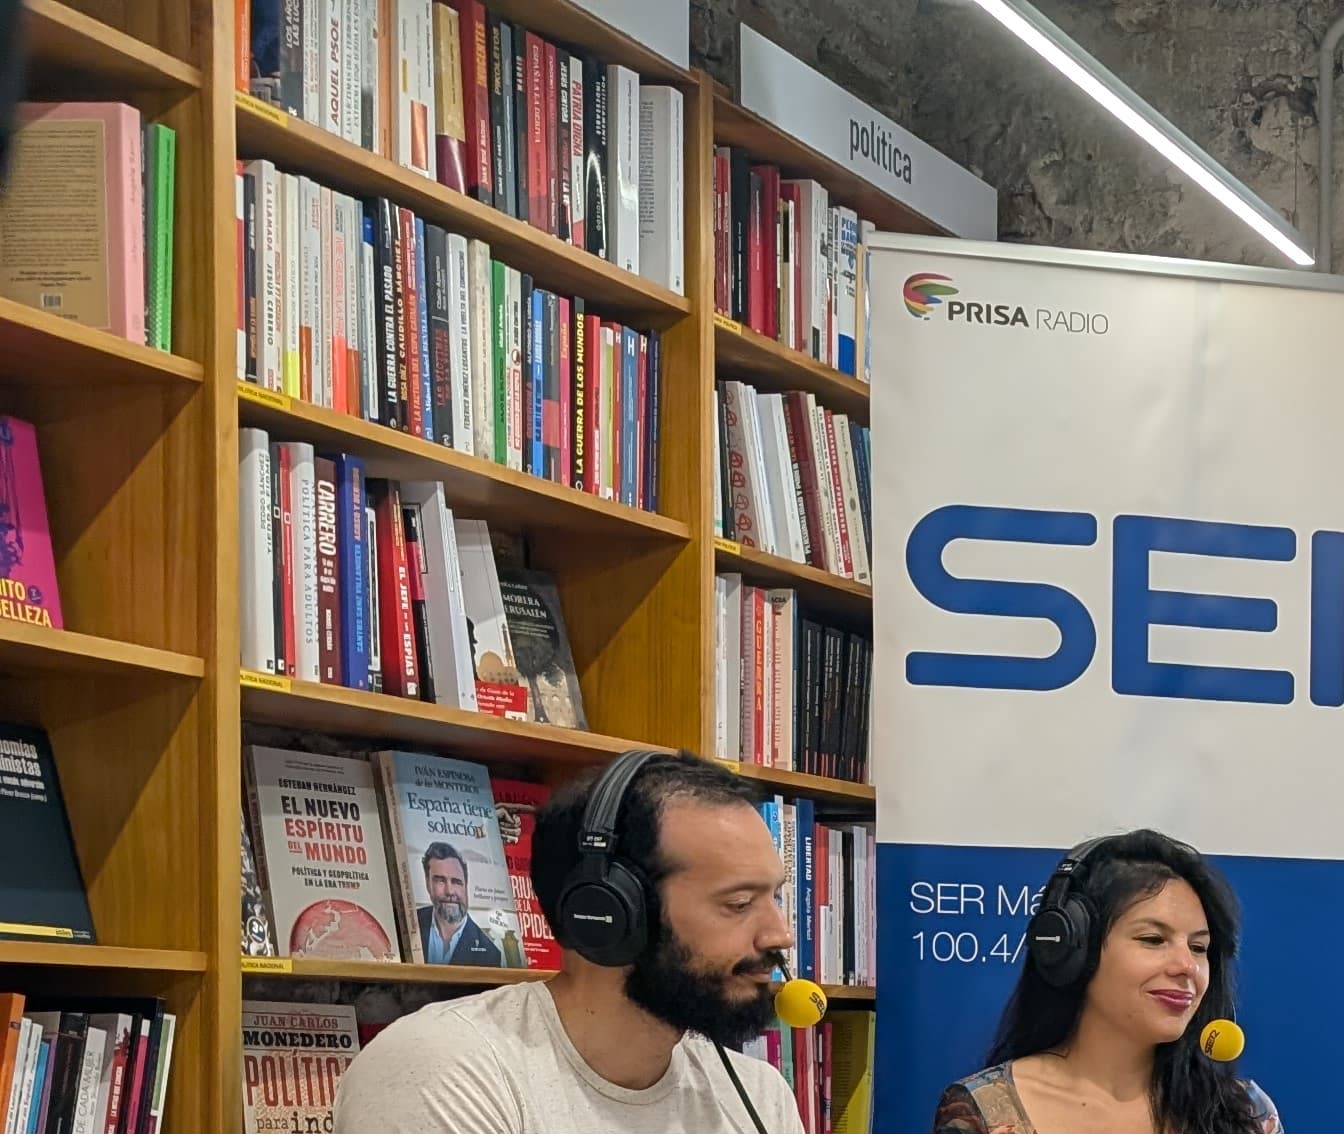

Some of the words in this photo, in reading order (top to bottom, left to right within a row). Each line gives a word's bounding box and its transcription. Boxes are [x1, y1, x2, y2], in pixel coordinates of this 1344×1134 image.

[331, 17, 339, 63] PSOE
[330, 68, 339, 126] AQUEL
[850, 119, 912, 184] política
[384, 265, 393, 301] PASADO
[385, 303, 394, 314] EL
[947, 301, 1028, 328] PRISA
[1036, 309, 1109, 335] RADIO
[386, 317, 395, 352] CONTRA
[575, 313, 585, 361] MUNDOS
[386, 354, 396, 389] GUERRA
[575, 364, 584, 388] LOS
[387, 391, 397, 403] LA
[575, 390, 584, 405] DE
[574, 408, 584, 456] GUERRA
[574, 458, 584, 474] LA
[302, 479, 310, 540] POLÍTICA
[318, 479, 336, 556] CARRERO
[398, 566, 404, 578] EL
[399, 580, 408, 610] JEFE
[305, 585, 313, 645] ADULTOS
[278, 779, 312, 790] ESTEBAN
[313, 781, 356, 795] HERNÁNDEZ
[281, 796, 302, 814] EL
[305, 798, 360, 821] NUEVO
[407, 791, 459, 816] España
[461, 801, 493, 820] tiene
[285, 818, 363, 843] ESPÍRITU
[305, 842, 367, 865] MUNDO
[804, 836, 812, 880] LIBERTAD
[909, 881, 984, 915] SER
[253, 1015, 286, 1026] JUAN
[290, 1016, 338, 1029] CARLOS
[242, 1031, 352, 1049] MONEDERO
[81, 1050, 94, 1083] MUJER
[77, 1086, 89, 1116] CADA
[74, 1119, 85, 1133] DE
[256, 1117, 289, 1133] para
